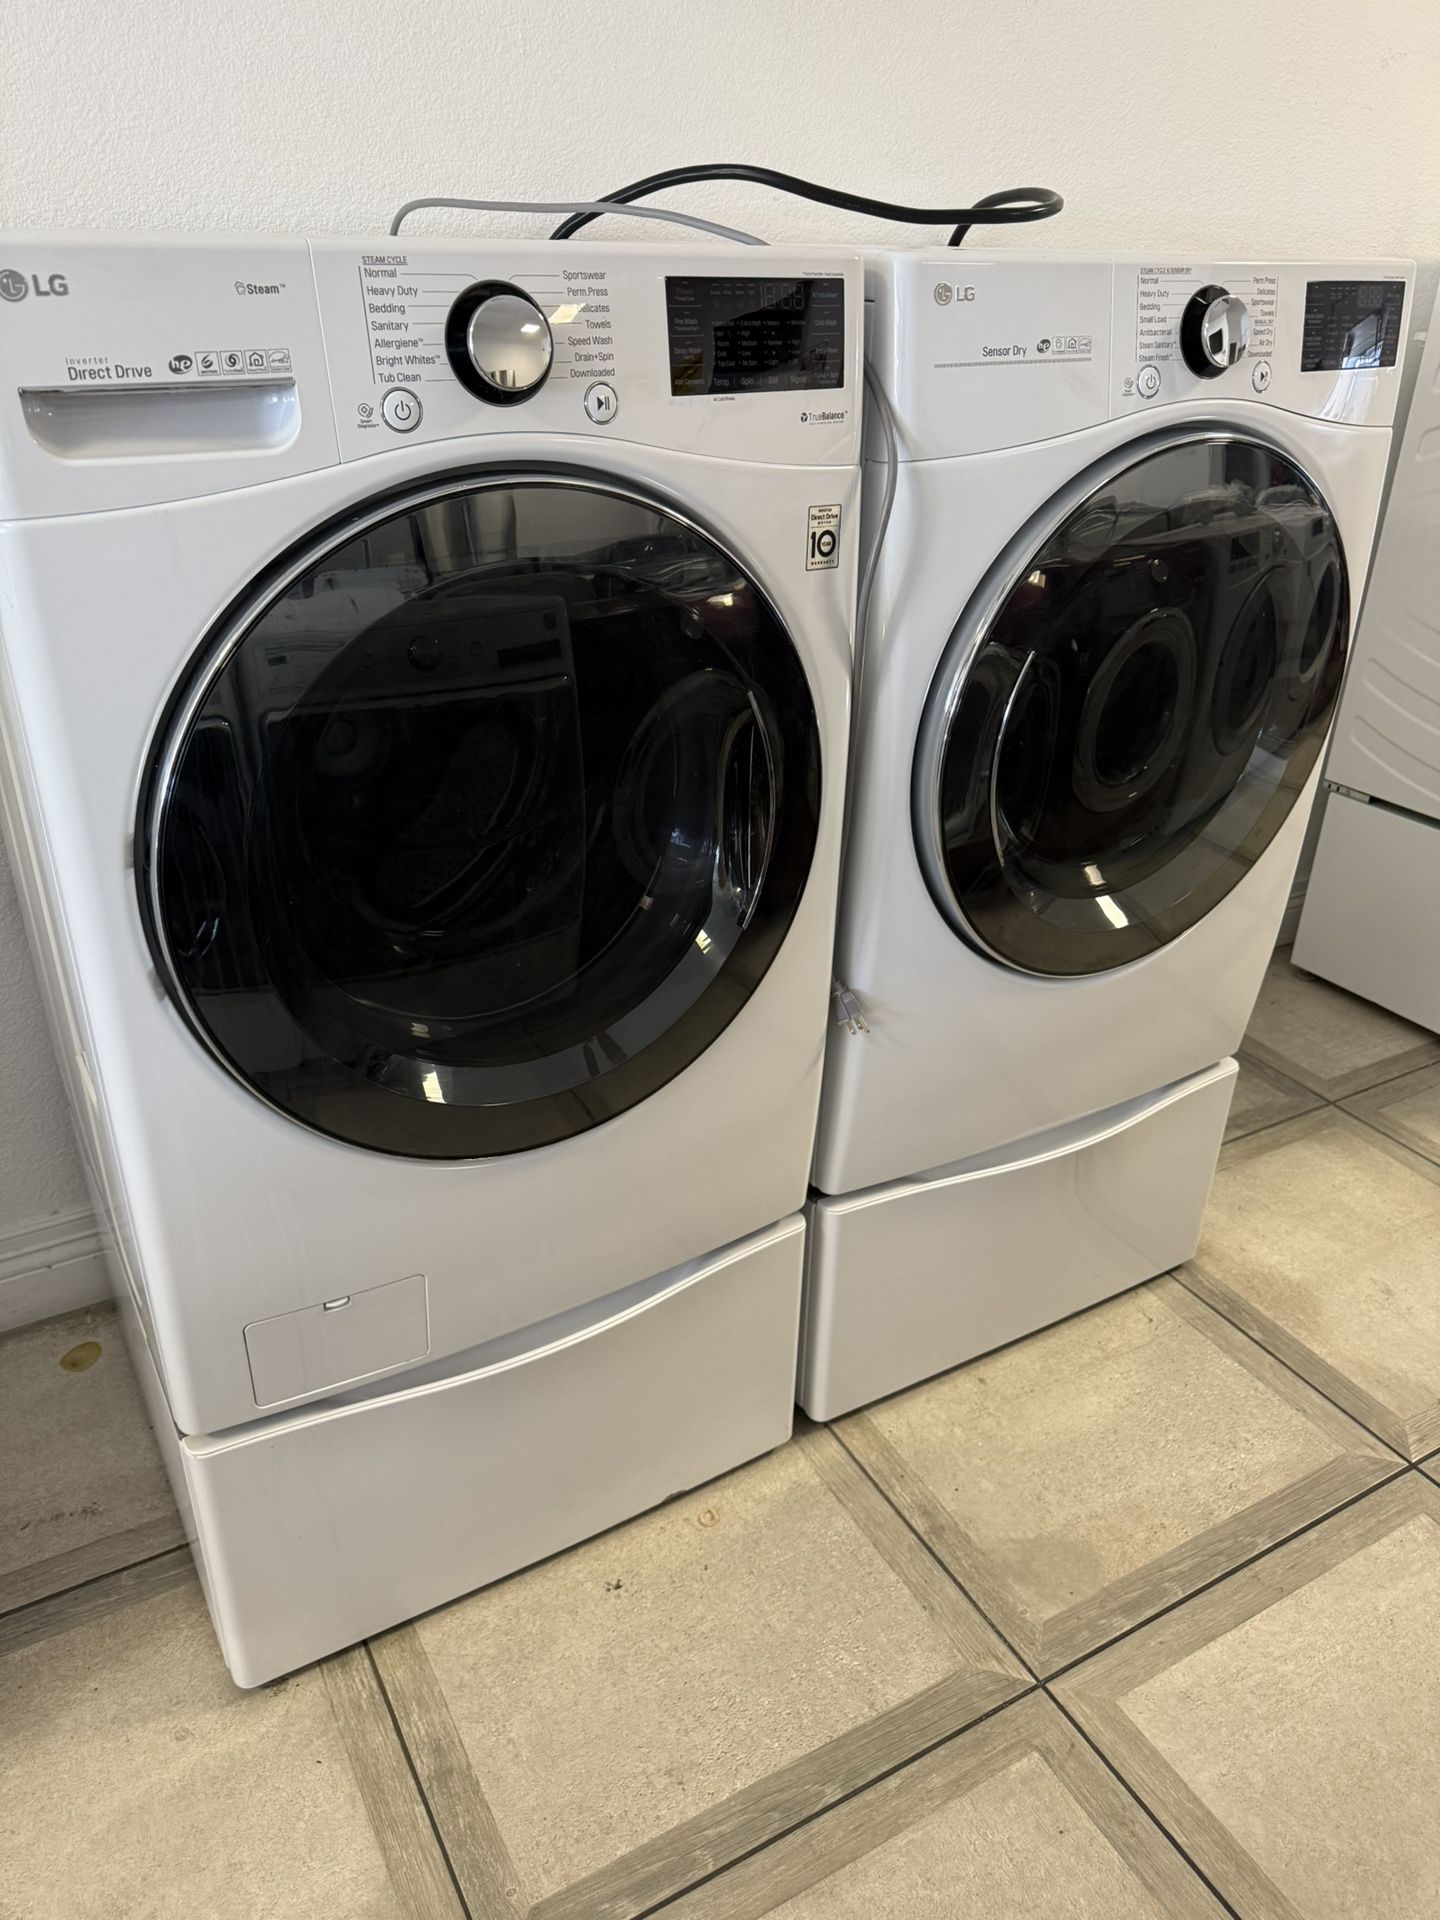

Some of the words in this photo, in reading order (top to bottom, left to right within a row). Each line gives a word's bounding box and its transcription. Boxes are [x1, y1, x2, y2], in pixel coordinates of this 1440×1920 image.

[362, 256, 385, 265] STEAM
[386, 256, 408, 265] CYCLE
[364, 268, 397, 278] Normal
[562, 270, 606, 281] Sportswear
[32, 274, 69, 296] LG
[367, 285, 395, 298] Heavy
[397, 285, 418, 298] Duty
[955, 286, 975, 302] LG
[1140, 289, 1156, 299] Heavy
[1157, 289, 1169, 299] Duty
[369, 303, 406, 315] Bedding
[1140, 303, 1161, 312] Bedding
[371, 321, 409, 332] Sanitary
[585, 320, 612, 329] Towels
[1139, 329, 1172, 337] Antibacterial
[567, 336, 591, 347] Speed
[592, 336, 613, 345] Wash
[1138, 341, 1154, 349] Steam
[982, 346, 1011, 357] Sensor
[1012, 345, 1027, 358] Dry
[65, 356, 109, 367] Inverter
[376, 356, 403, 367] Bright
[574, 352, 614, 363] Drain+Spin
[1138, 354, 1155, 362] Steam
[68, 365, 112, 381] Direct
[115, 364, 153, 378] Drive
[378, 372, 395, 383] Tub
[397, 372, 421, 383] Clean
[570, 367, 615, 378] Downloaded
[810, 529, 837, 559] 10
